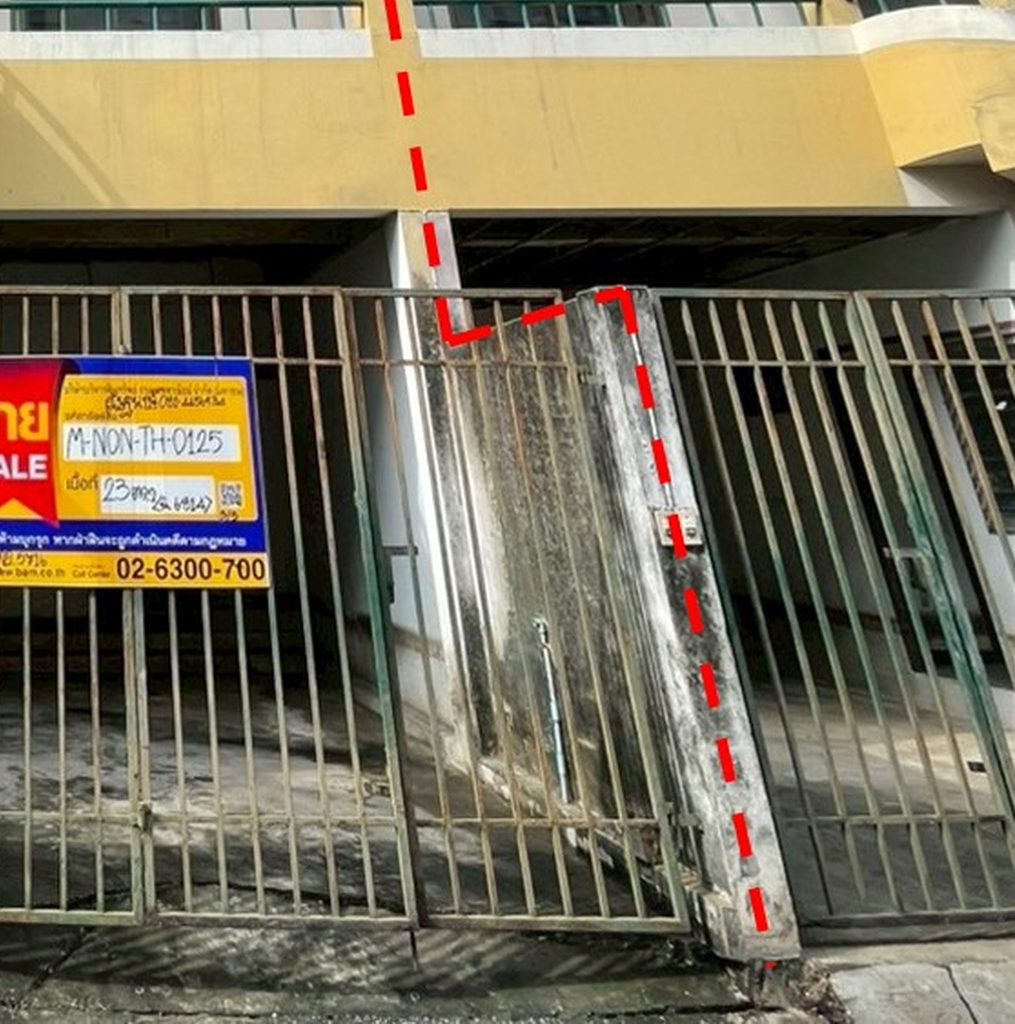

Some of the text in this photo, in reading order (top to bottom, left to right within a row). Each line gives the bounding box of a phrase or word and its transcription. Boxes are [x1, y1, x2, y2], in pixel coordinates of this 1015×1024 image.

[66, 425, 224, 458] M-NON-TH-0125
[102, 477, 130, 502] 23
[117, 557, 265, 580] 02-6300-700
